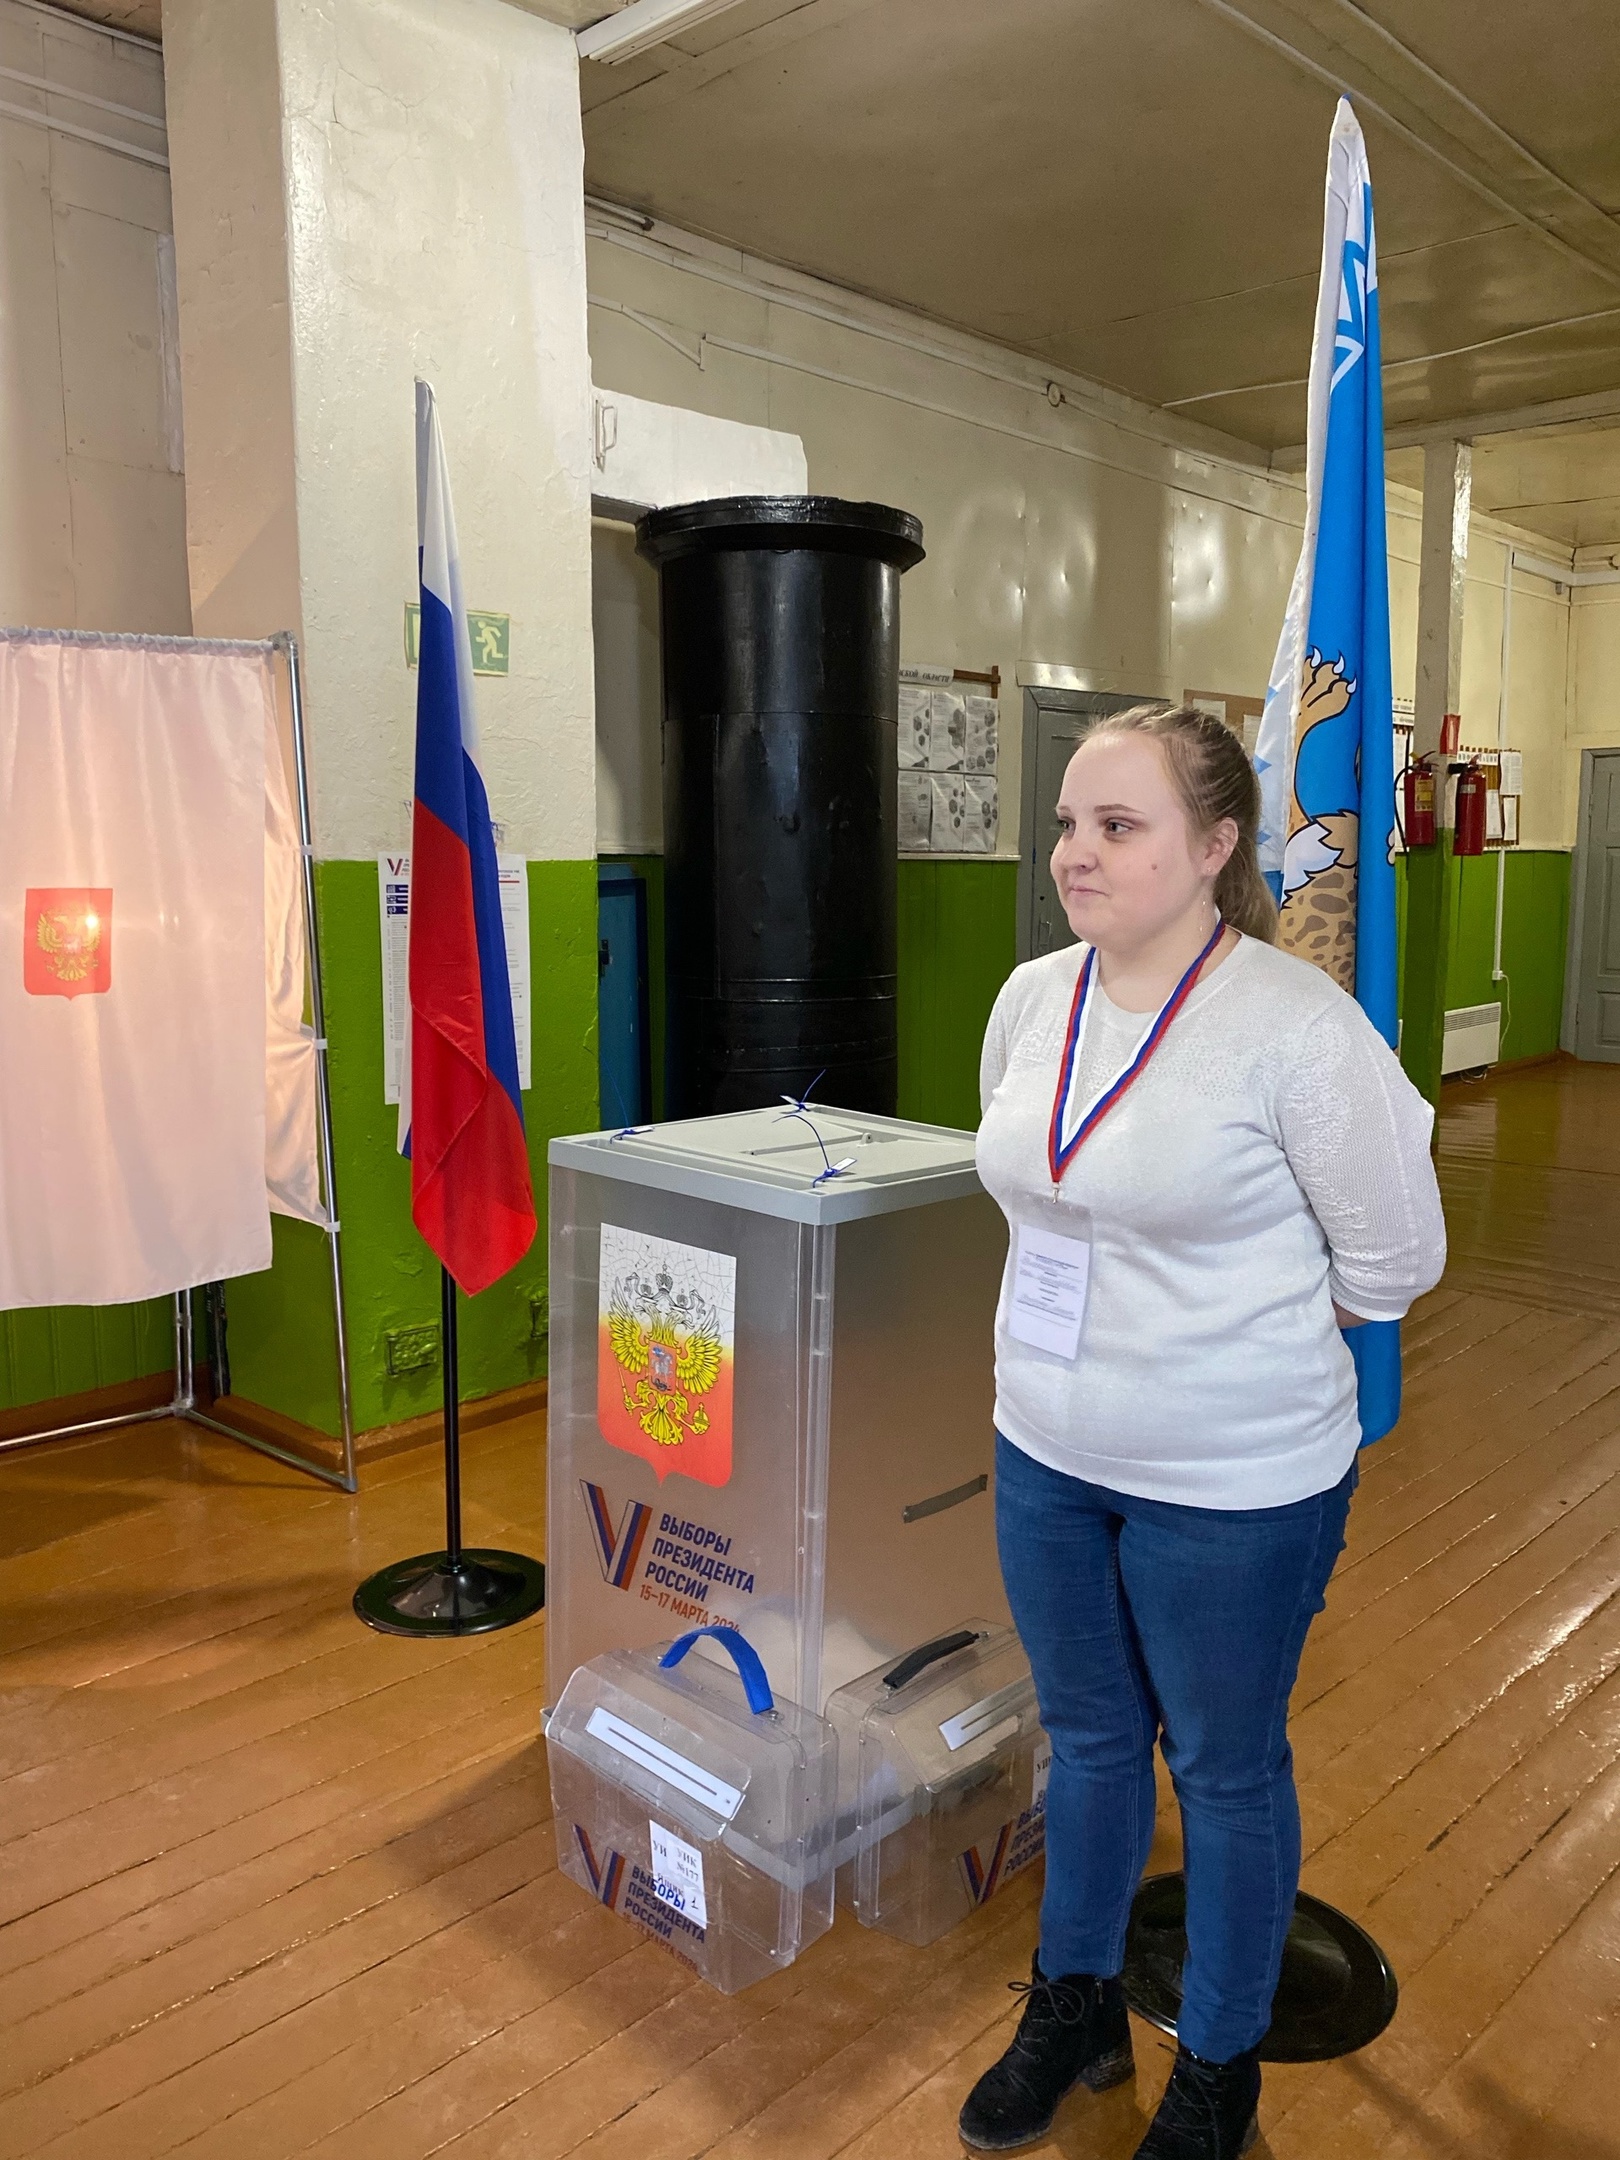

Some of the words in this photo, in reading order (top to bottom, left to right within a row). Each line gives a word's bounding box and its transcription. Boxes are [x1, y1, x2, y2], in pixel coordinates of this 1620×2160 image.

[659, 1513, 732, 1556] ВЫБОРЫ
[644, 1560, 710, 1602] РОССИИ
[652, 1537, 755, 1594] ПРЕЗИДЕНТА
[669, 1597, 709, 1627] МАРТА
[677, 1847, 697, 1868] УИК
[632, 1866, 686, 1911] ВЫБОРЫ
[624, 1897, 673, 1940] РОССИИ
[627, 1881, 705, 1944] ПРЕЗИДЕНТА
